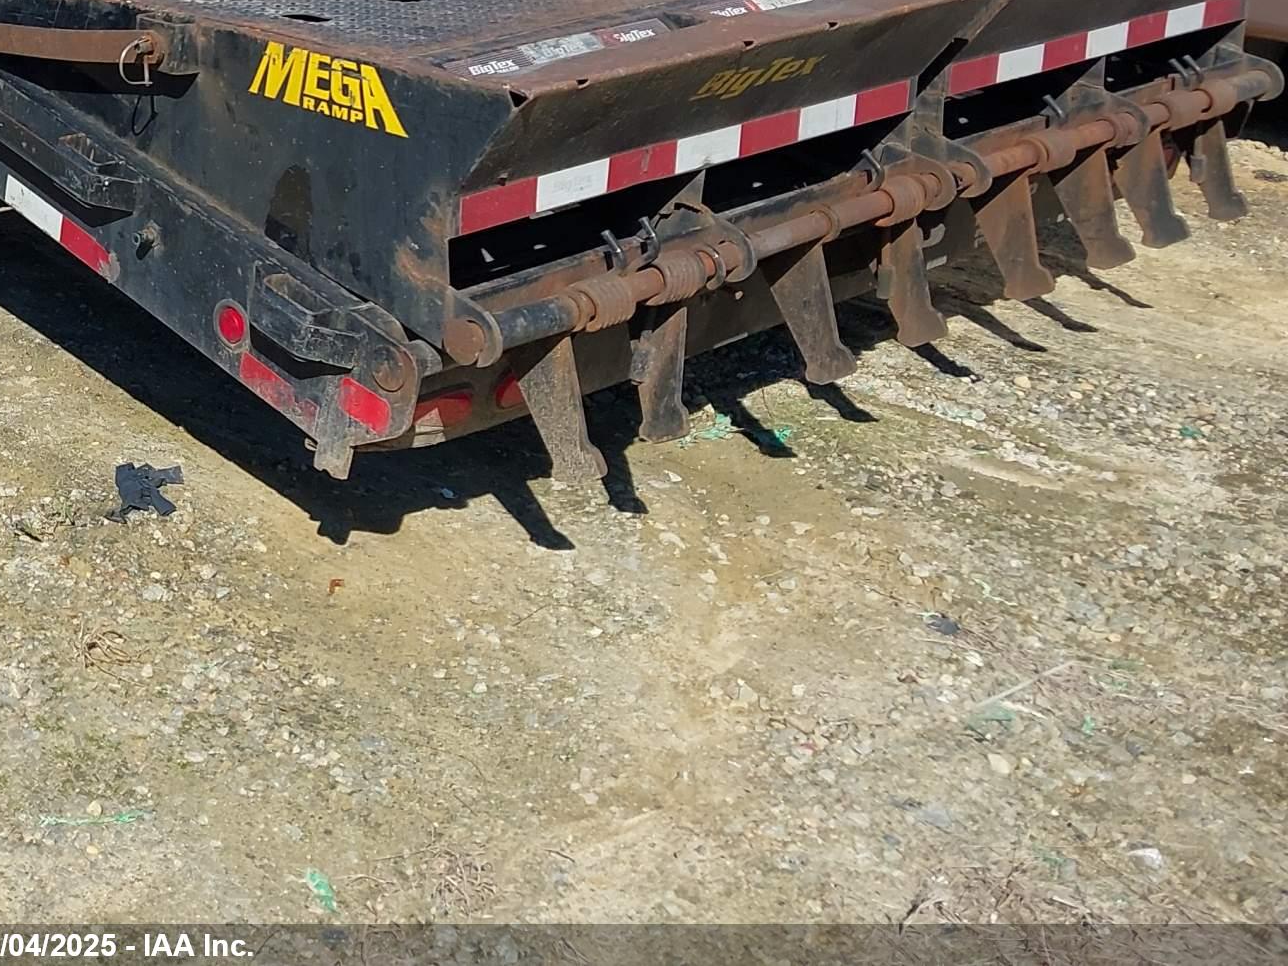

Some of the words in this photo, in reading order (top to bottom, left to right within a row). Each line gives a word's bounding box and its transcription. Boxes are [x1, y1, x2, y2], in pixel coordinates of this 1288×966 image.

[468, 58, 517, 76] BigTex
[689, 52, 828, 102] BigTex
[248, 41, 409, 138] MEGA
[302, 96, 363, 124] RAMP
